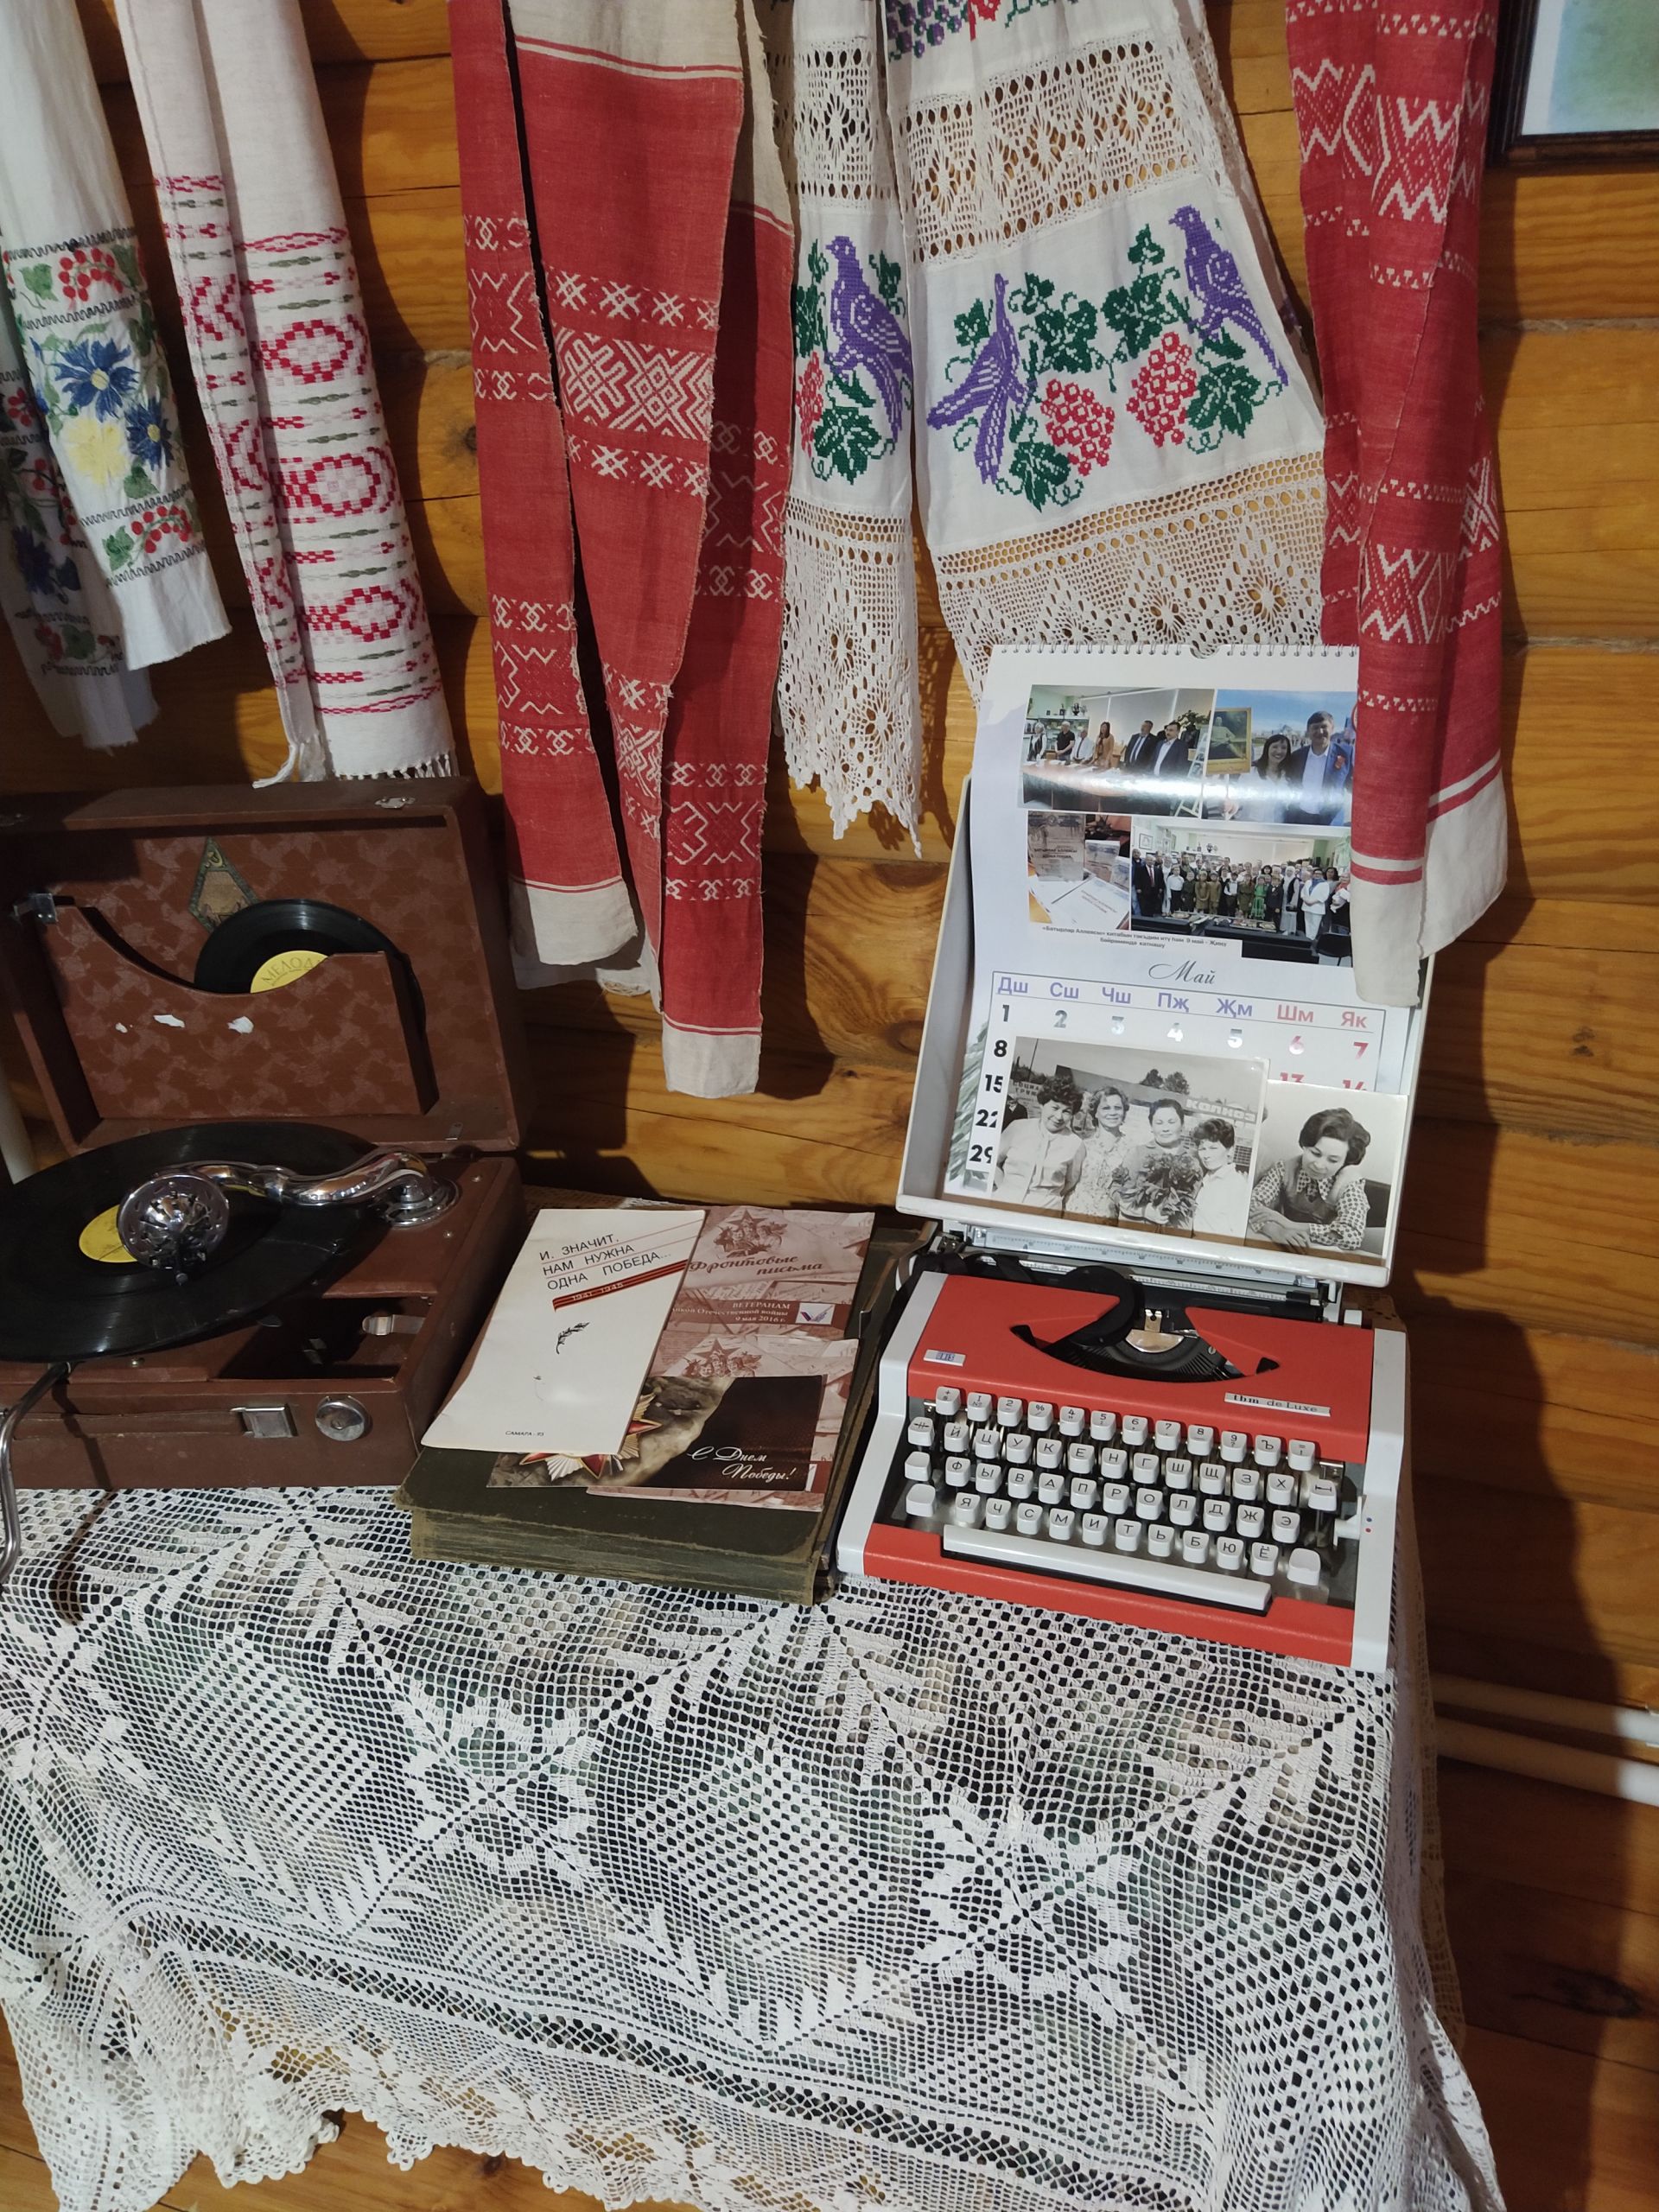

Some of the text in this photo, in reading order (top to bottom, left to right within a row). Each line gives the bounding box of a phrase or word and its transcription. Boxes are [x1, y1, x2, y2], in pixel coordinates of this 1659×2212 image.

[261, 957, 319, 984] МЕЛОД
[1148, 960, 1217, 984] Май
[998, 976, 1028, 995] Дш
[1050, 982, 1078, 999] Сш
[1102, 987, 1131, 1004] Чш
[1276, 1004, 1314, 1023] Шм
[1340, 1011, 1367, 1029] Як
[1002, 1004, 1369, 1060] 1 2 3 4 5 6 7
[994, 1039, 1008, 1058] 8
[985, 1074, 1003, 1093] 15
[969, 1144, 993, 1164] 29
[543, 1244, 635, 1276] НАМ НУЖНА
[688, 1255, 799, 1274] Фронтовые
[756, 1263, 823, 1276] письма
[547, 1273, 588, 1291] ОДНА
[1287, 1402, 1318, 1413] Luxe
[687, 1446, 767, 1462] С Днем
[950, 1426, 961, 1437] Й
[982, 1433, 992, 1444] Ц
[1014, 1438, 1024, 1446] У
[1044, 1443, 1055, 1452] К
[1076, 1448, 1086, 1458] Е
[1109, 1453, 1119, 1462] Н
[1142, 1458, 1152, 1466] Г
[1172, 1462, 1185, 1472] Ш
[1205, 1467, 1219, 1478] Щ
[1277, 1478, 1287, 1488] Х
[721, 1463, 797, 1483] Победы!
[952, 1461, 963, 1471] Ф
[981, 1468, 995, 1478] Ы
[1015, 1473, 1025, 1482] В
[1045, 1478, 1055, 1487] А
[1077, 1484, 1089, 1492] П
[1111, 1488, 1122, 1497] Р
[1176, 1499, 1189, 1509] Л
[1209, 1504, 1224, 1516] Д
[1243, 1510, 1257, 1521] Ж
[1281, 1516, 1292, 1525] Э
[960, 1497, 1270, 1558] Я Ч С М И Т Ь Б Ю Ё
